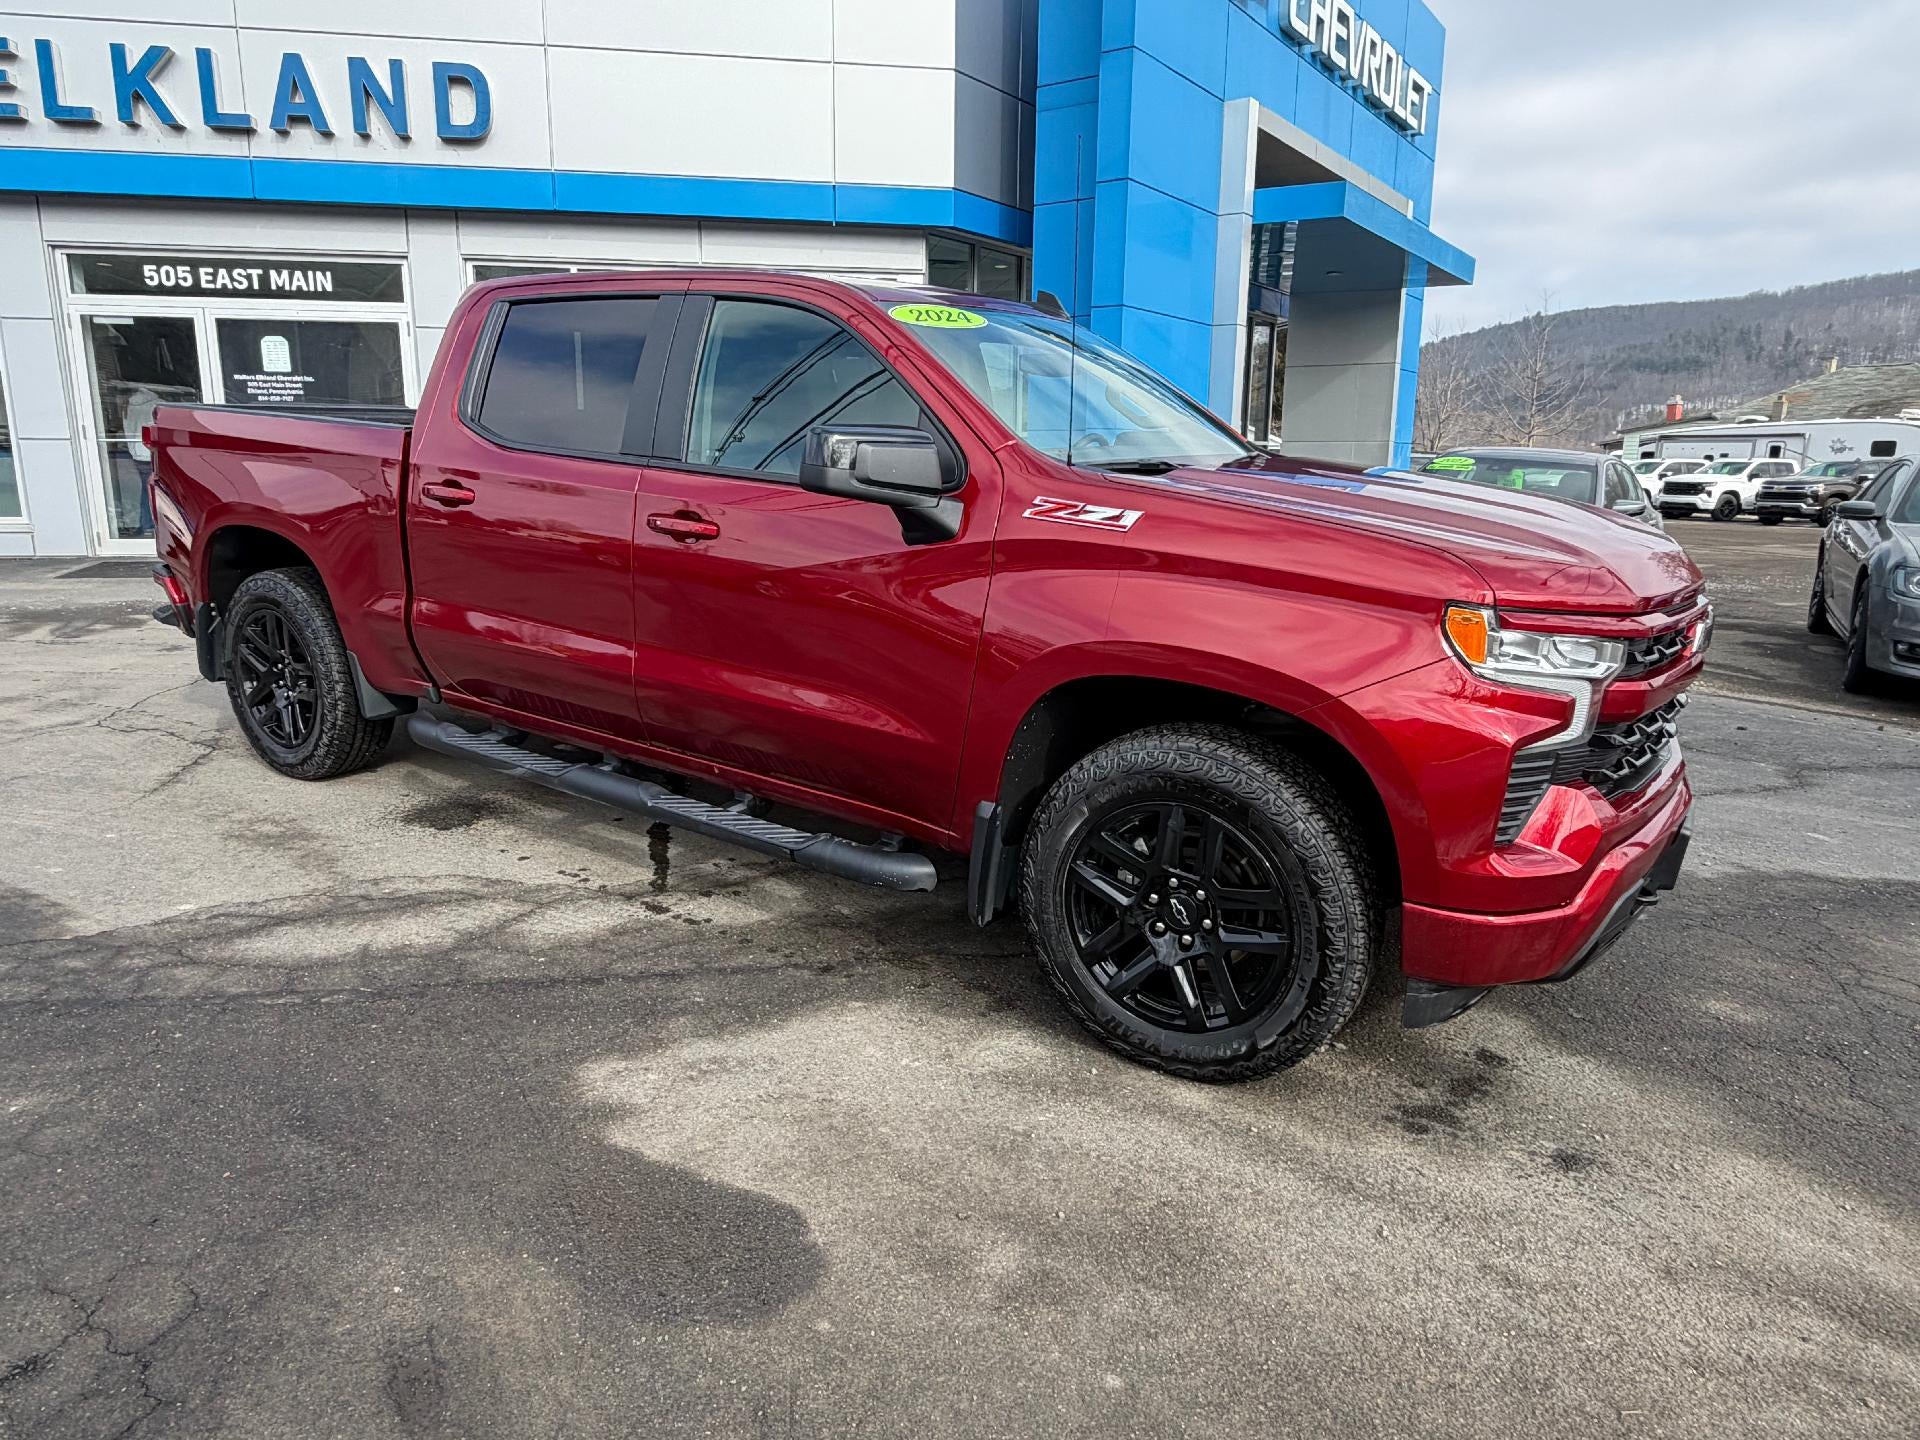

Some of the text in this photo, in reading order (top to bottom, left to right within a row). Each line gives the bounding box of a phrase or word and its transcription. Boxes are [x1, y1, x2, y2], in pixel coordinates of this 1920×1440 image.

[142, 264, 333, 292] 505 EAST MAIN
[909, 309, 973, 323] 2024
[1022, 496, 1145, 532] Z71
